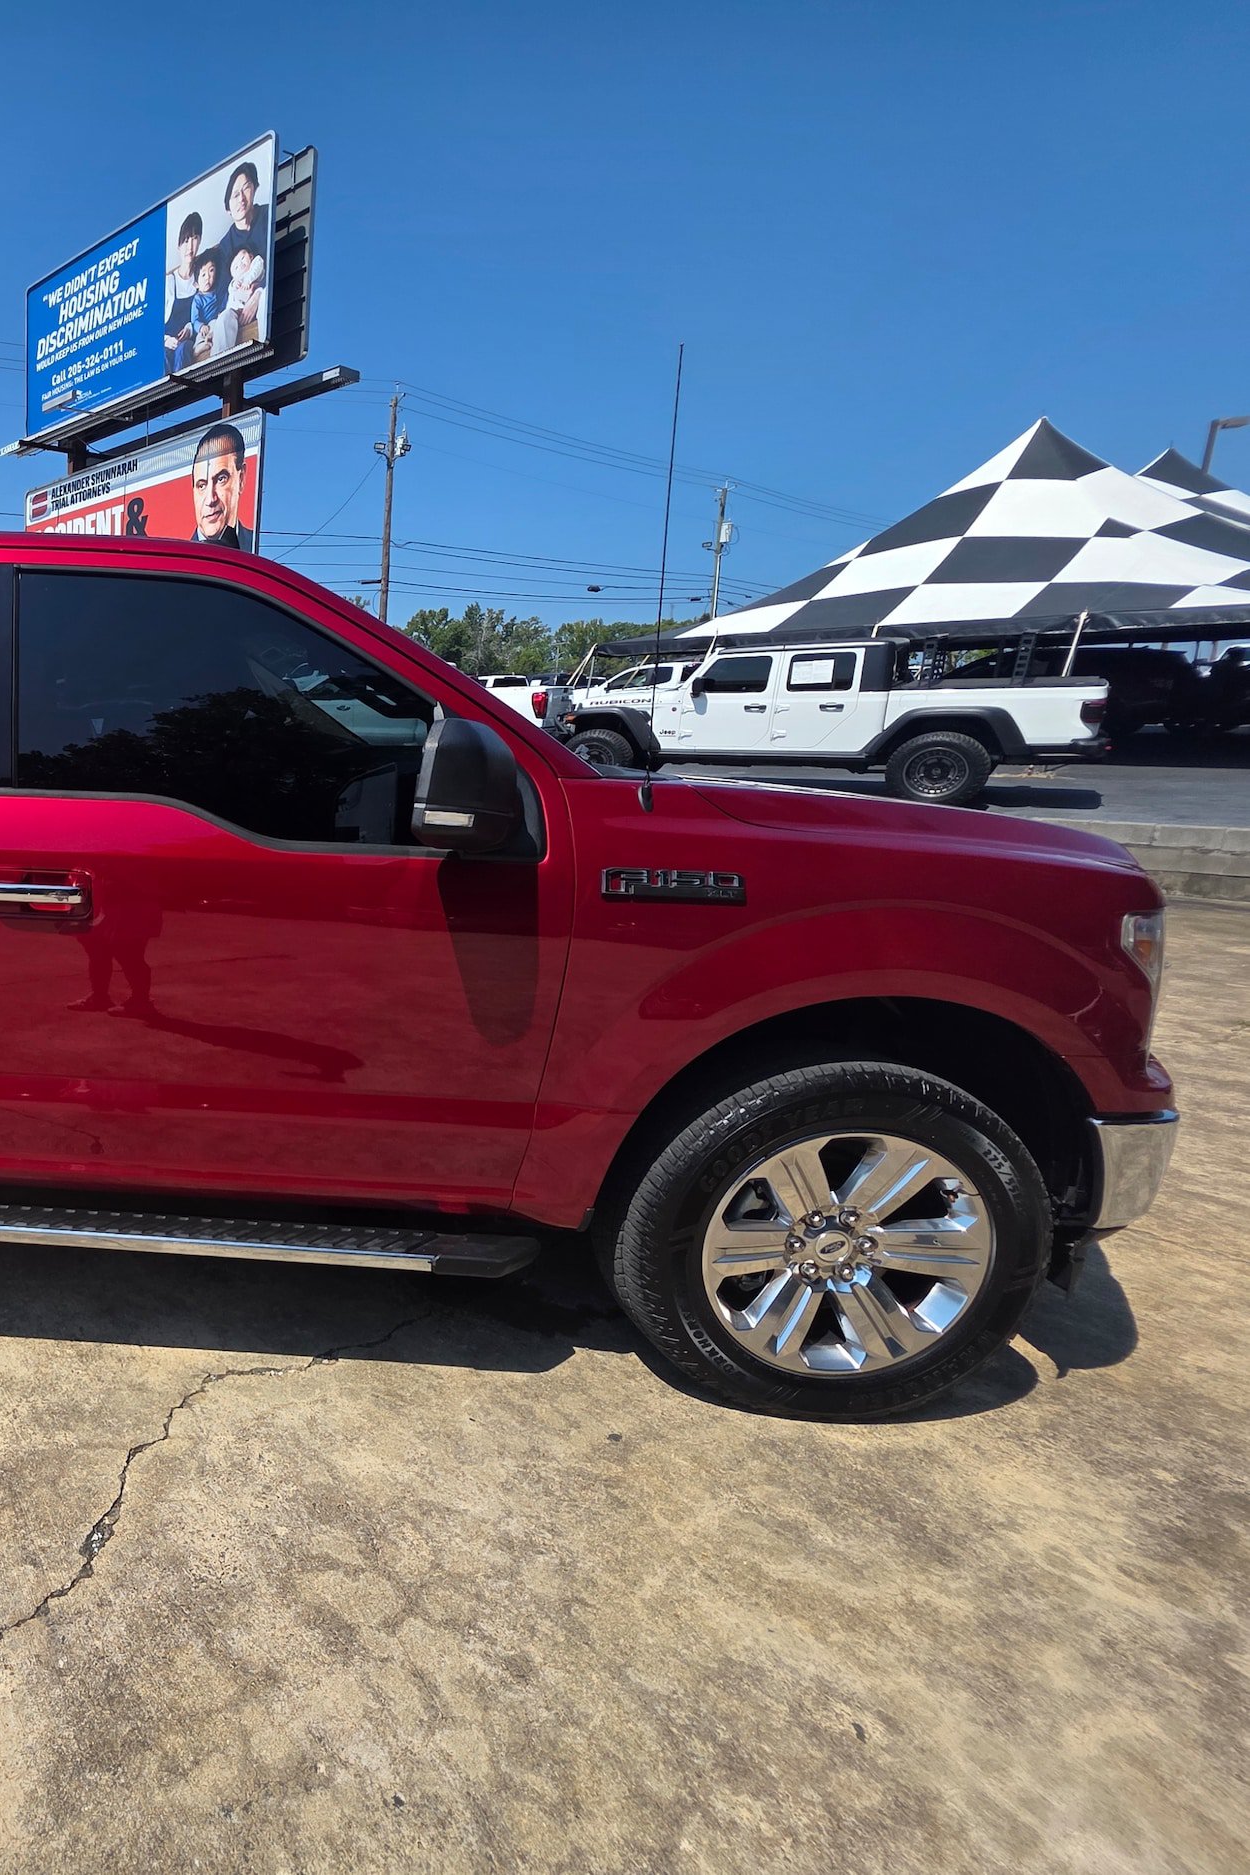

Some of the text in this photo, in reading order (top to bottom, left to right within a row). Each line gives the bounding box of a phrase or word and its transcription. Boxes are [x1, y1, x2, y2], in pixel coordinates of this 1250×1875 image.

[64, 264, 98, 299] DIDN'T
[97, 238, 140, 278] EXPECT
[36, 278, 147, 360] DISCRIMINATION
[59, 270, 120, 325] HOUSING
[36, 354, 55, 372] WOULD
[55, 346, 70, 362] KEEP
[69, 341, 78, 354] US
[78, 332, 95, 349] FROM
[95, 325, 108, 340] OUR
[107, 316, 124, 333] NEW
[51, 339, 124, 387] Call 205-324-0111
[41, 390, 52, 402] FAIR
[74, 375, 84, 385] THE
[83, 368, 95, 381] LAW
[95, 365, 102, 375] IS
[101, 361, 110, 372] ON
[109, 354, 124, 367] YOUR
[51, 459, 138, 500] ALEXANDER SHUNNARAH
[51, 482, 111, 512] TRIAL ATTORNEYS
[125, 497, 149, 537] &
[590, 698, 652, 706] RUBICON
[707, 889, 738, 898] XLT
